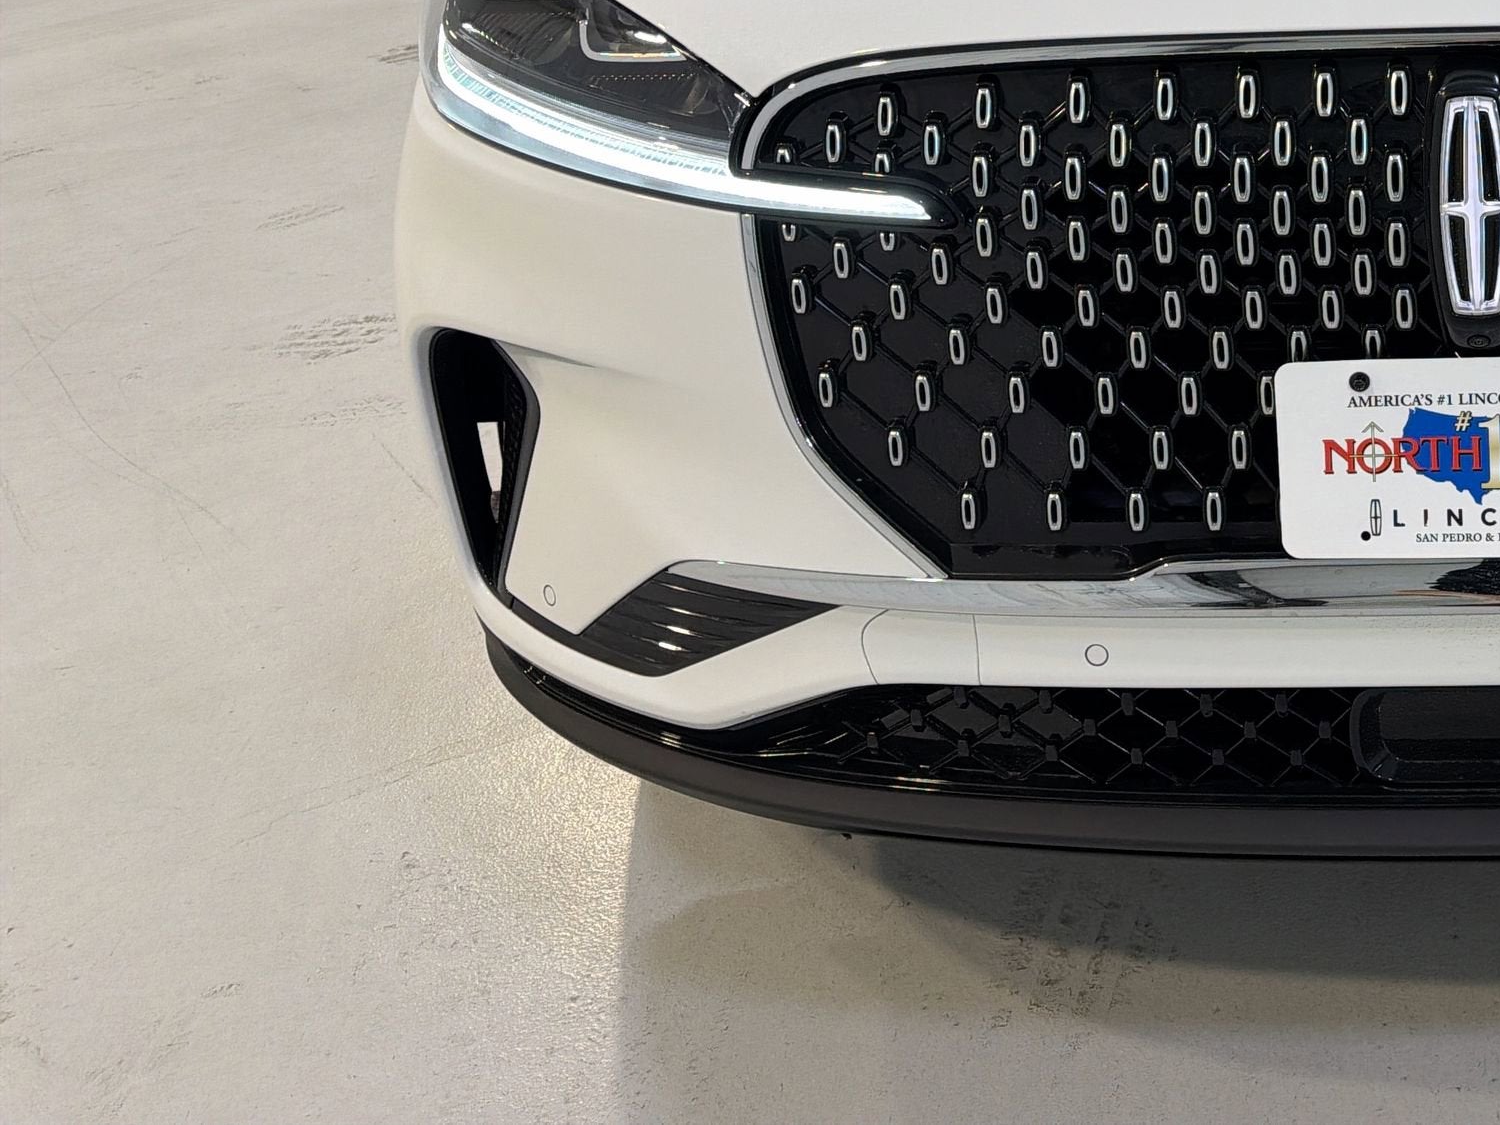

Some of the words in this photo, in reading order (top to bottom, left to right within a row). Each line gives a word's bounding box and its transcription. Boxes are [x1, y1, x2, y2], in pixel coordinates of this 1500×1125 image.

[1347, 393, 1433, 408] AMERICA'S
[1437, 393, 1453, 406] #1
[1322, 435, 1482, 475] NORTH
[1415, 533, 1439, 543] SAN
[1442, 532, 1482, 543] PEDRO
[1485, 532, 1495, 542] &
